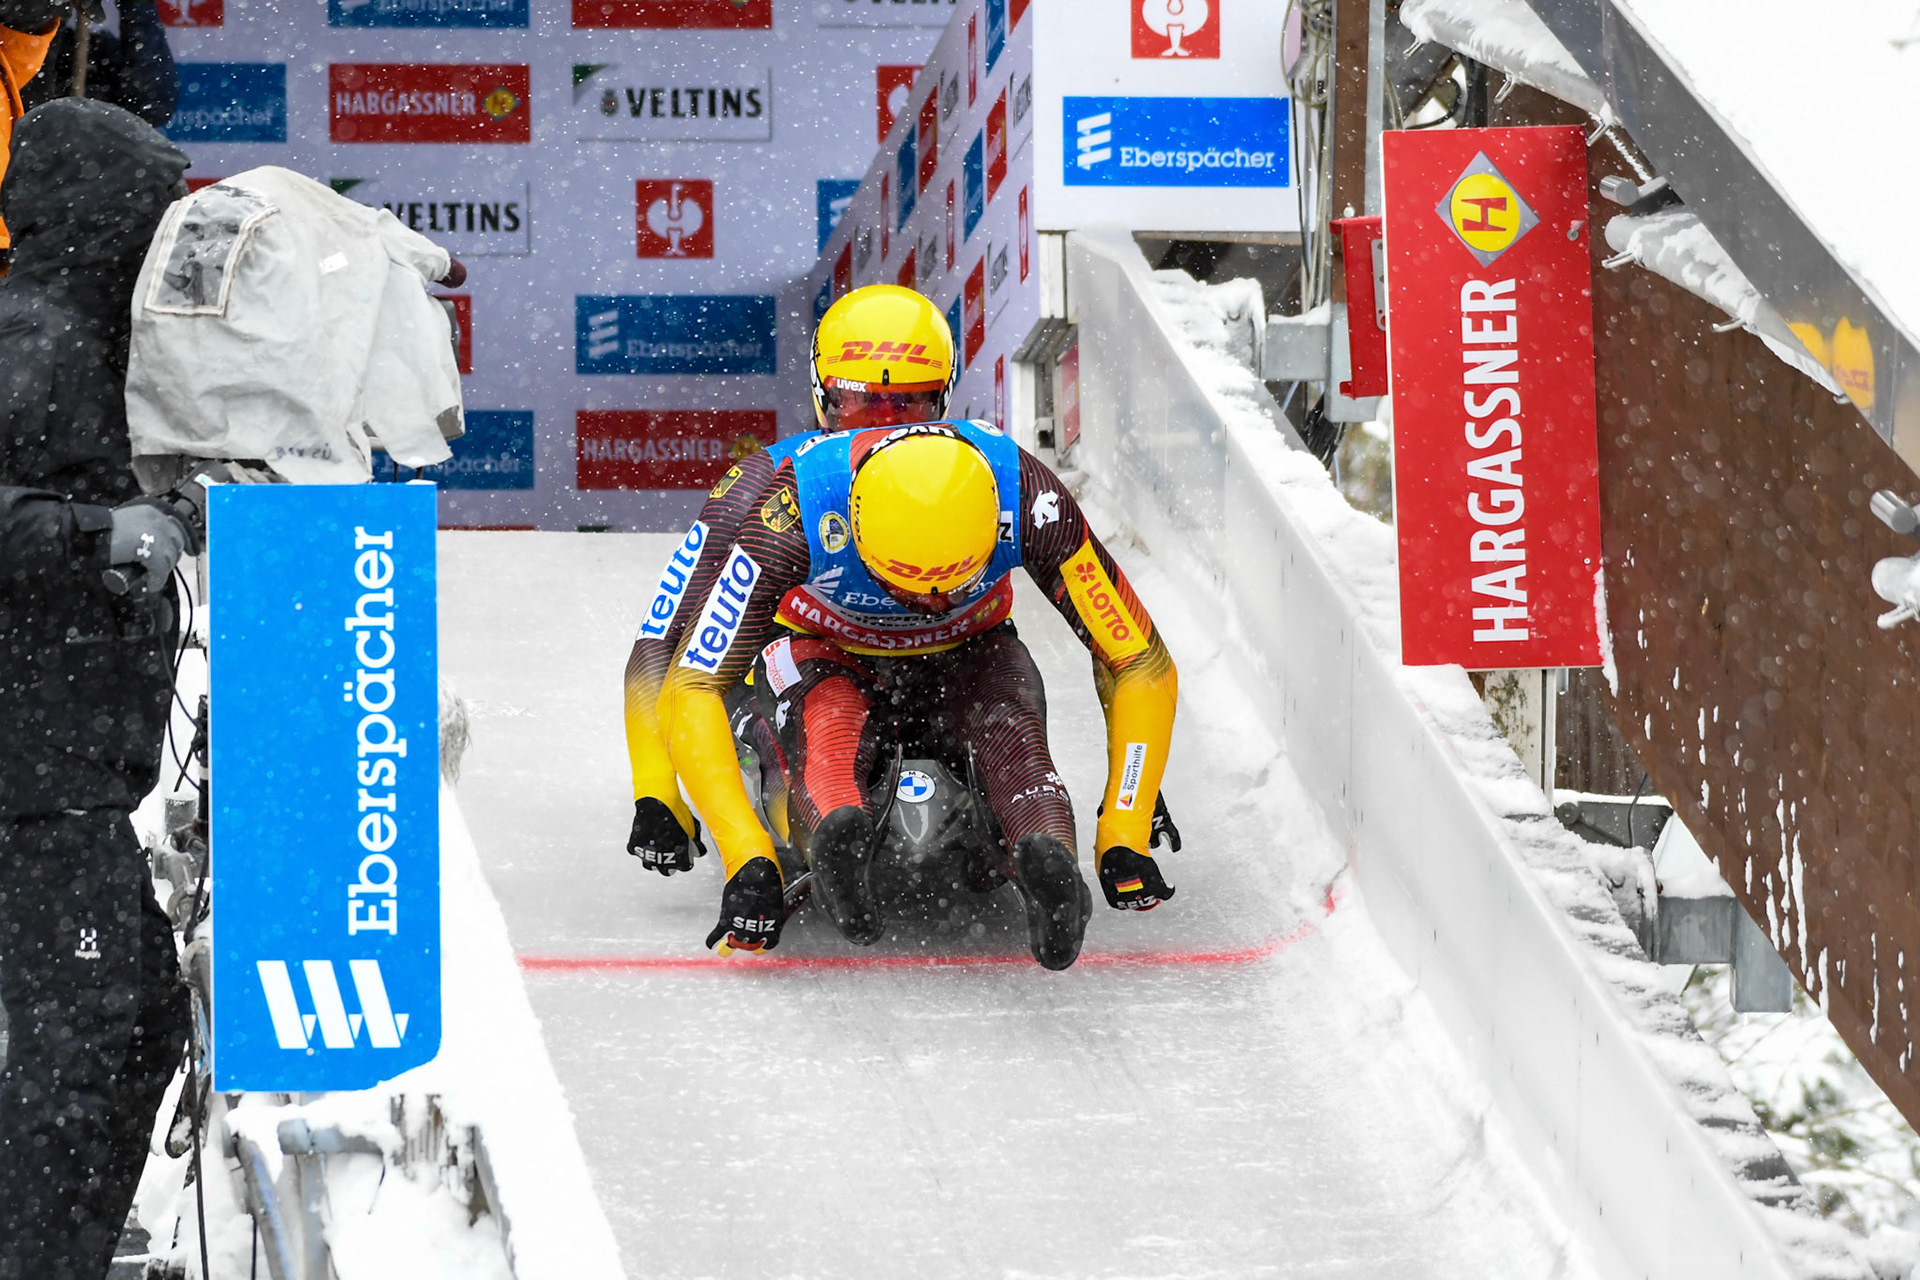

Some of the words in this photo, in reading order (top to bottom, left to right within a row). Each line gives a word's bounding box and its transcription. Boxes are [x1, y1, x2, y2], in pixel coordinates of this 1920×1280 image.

[335, 92, 477, 115] HARGASSNER
[626, 88, 762, 118] VELTINS
[1119, 146, 1275, 172] Eberspächer
[840, 341, 931, 365] DHL
[836, 378, 867, 393] uvex
[583, 438, 723, 461] HARGASSNER
[1461, 278, 1529, 642] HARGASSNER
[640, 523, 703, 636] teuto
[885, 554, 974, 581] DHL
[685, 554, 755, 669] teuto
[1086, 582, 1130, 642] LOTTO
[344, 526, 408, 936] Eberspächer
[1127, 744, 1143, 791] Sporthilfe
[634, 846, 676, 865] SEIZ
[1116, 894, 1157, 909] SEIZ
[733, 915, 776, 933] SEIZ
